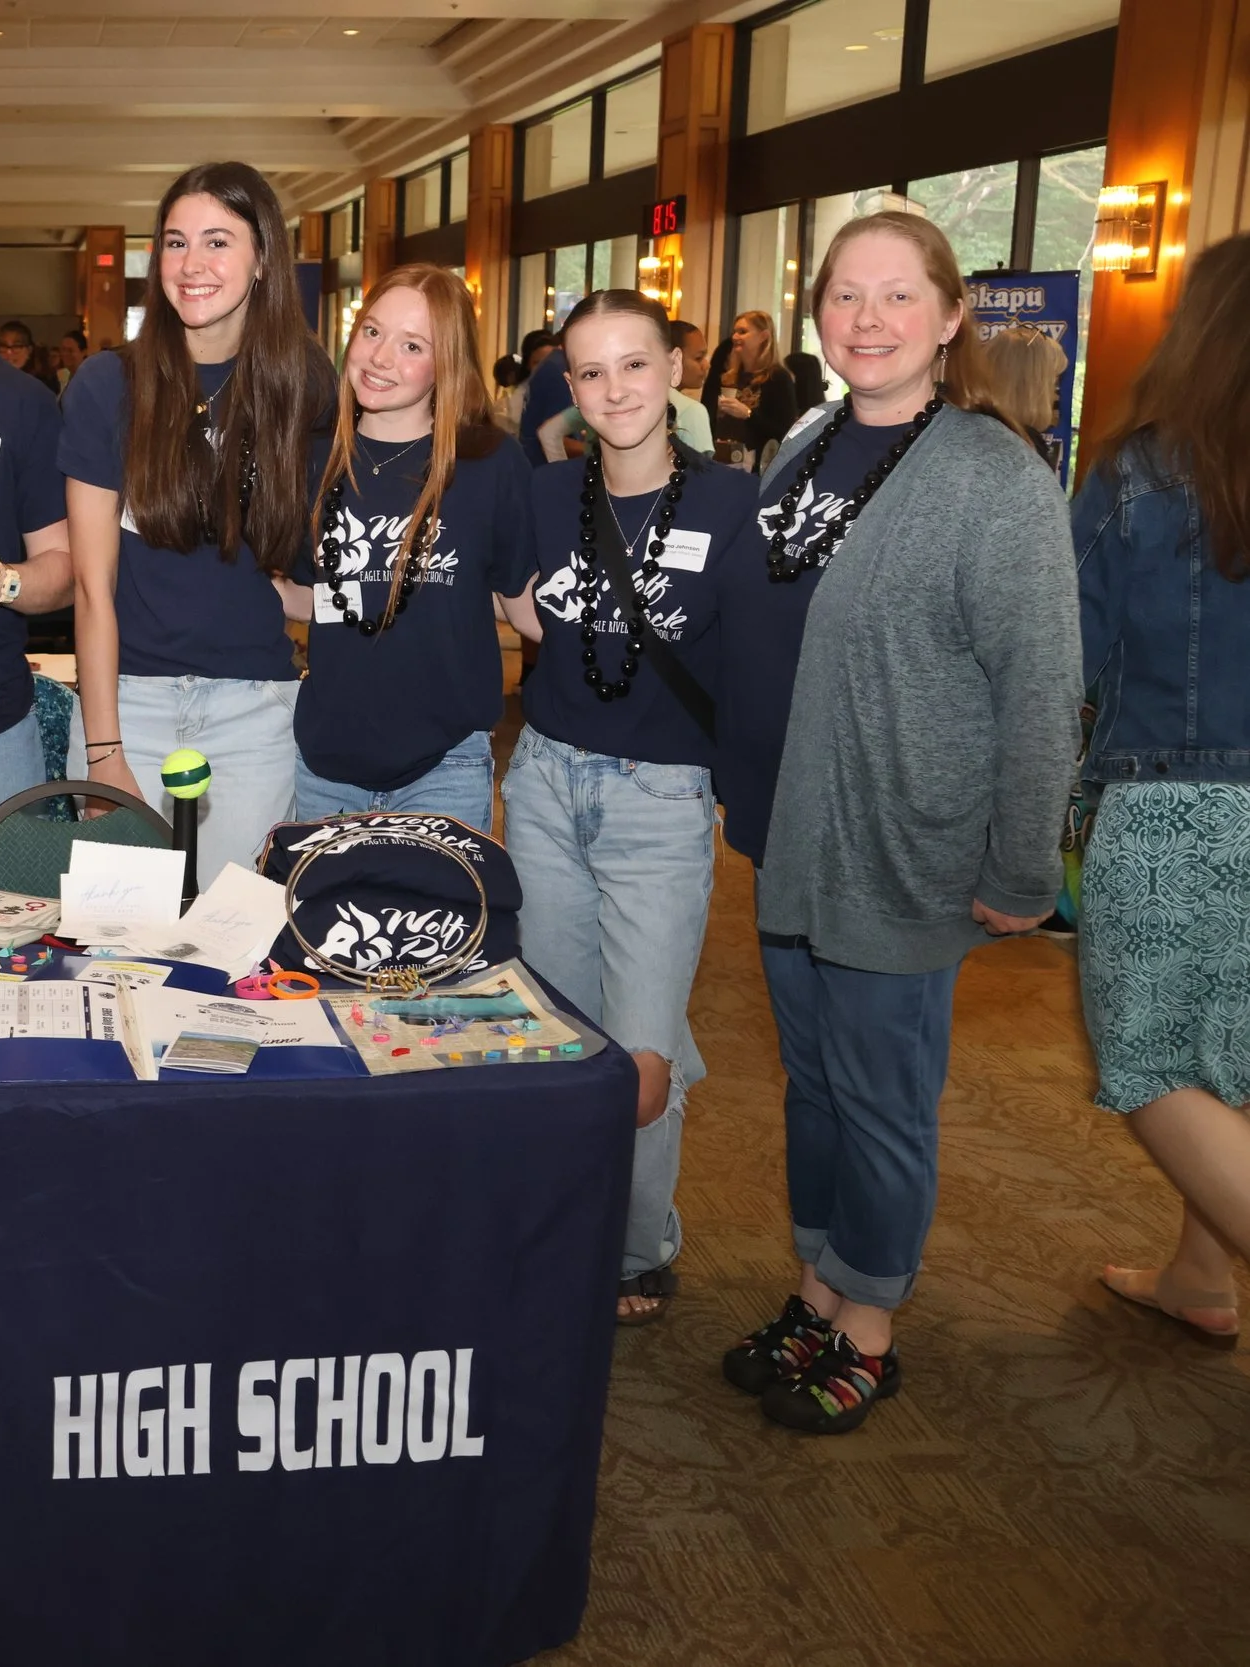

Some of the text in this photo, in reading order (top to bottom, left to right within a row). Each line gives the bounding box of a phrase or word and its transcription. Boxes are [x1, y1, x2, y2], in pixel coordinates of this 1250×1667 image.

[359, 570, 381, 582] EAGLE
[381, 907, 470, 950] Wolf
[52, 1348, 485, 1480] HIGH SCHOOL
